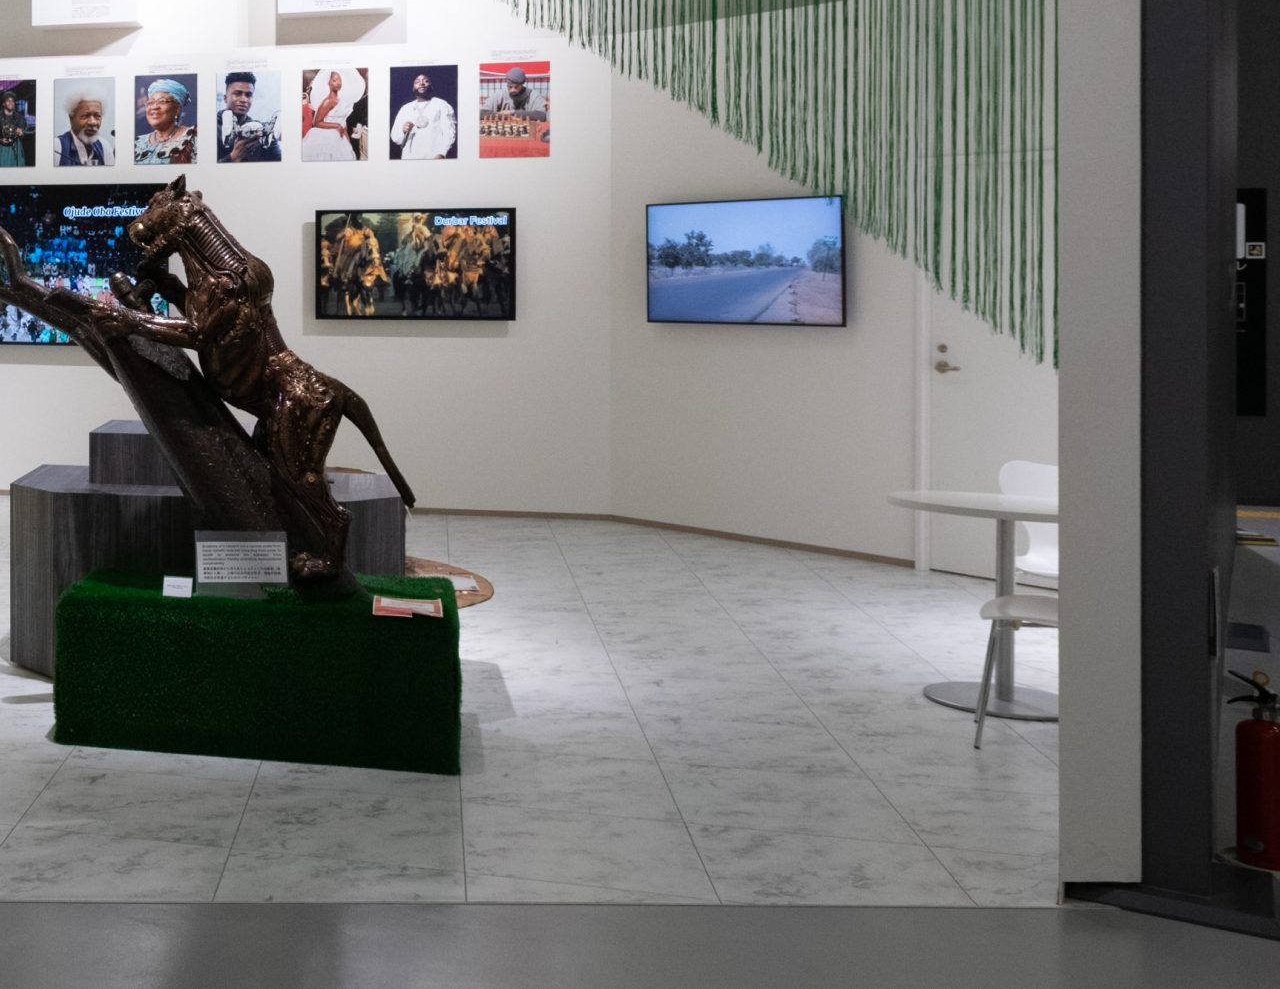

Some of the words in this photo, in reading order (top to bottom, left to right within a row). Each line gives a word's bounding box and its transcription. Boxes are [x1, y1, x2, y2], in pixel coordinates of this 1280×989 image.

[63, 206, 91, 220] Ojude
[92, 206, 112, 217] Oba
[434, 215, 468, 226] Durbar
[469, 215, 508, 226] Festival
